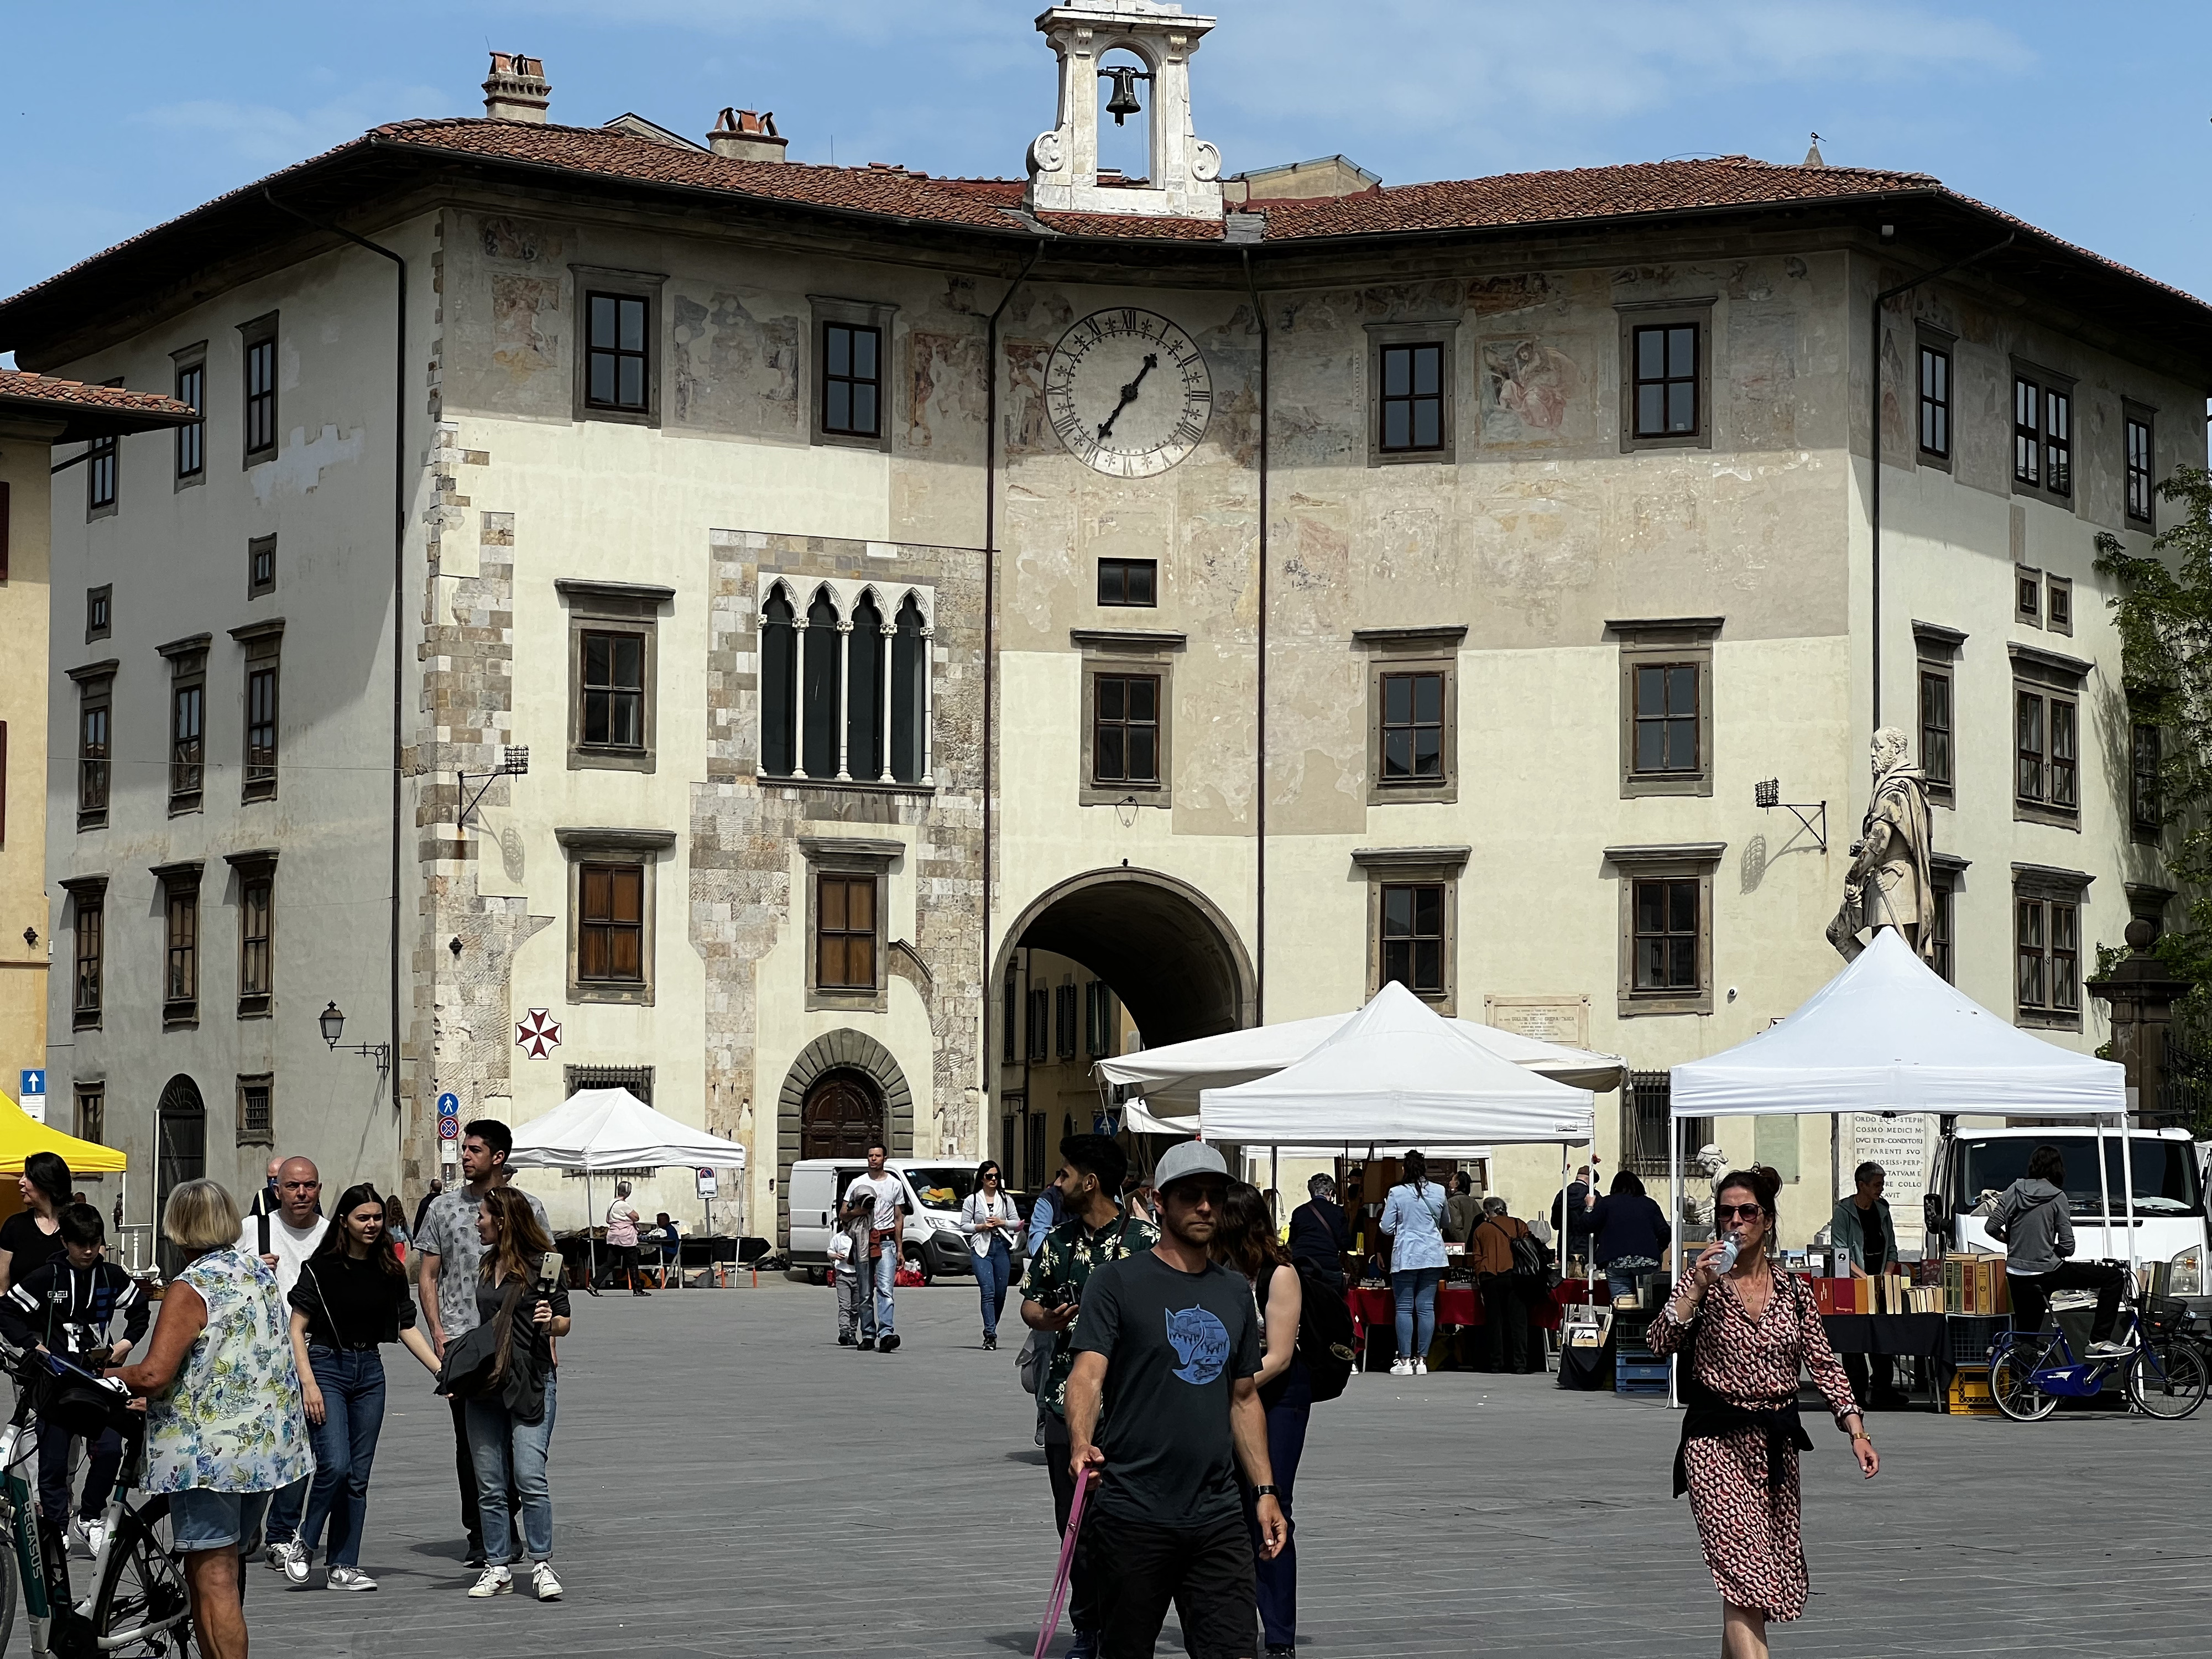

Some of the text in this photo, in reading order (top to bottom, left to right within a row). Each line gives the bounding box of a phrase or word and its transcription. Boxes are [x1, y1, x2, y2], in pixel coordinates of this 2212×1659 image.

[1083, 317, 1102, 339] XI
[1121, 310, 1136, 330] XII
[1159, 322, 1171, 339] I
[1056, 345, 1077, 362] X
[1181, 352, 1201, 367] II
[1047, 383, 1067, 395] IX
[1191, 390, 1211, 402] III
[1053, 414, 1076, 440] VIII
[1179, 421, 1203, 444] IIII
[1082, 442, 1100, 468] VII
[1160, 450, 1173, 469] V
[1123, 456, 1134, 476] VI
[24, 1501, 43, 1579] PEGASUS
